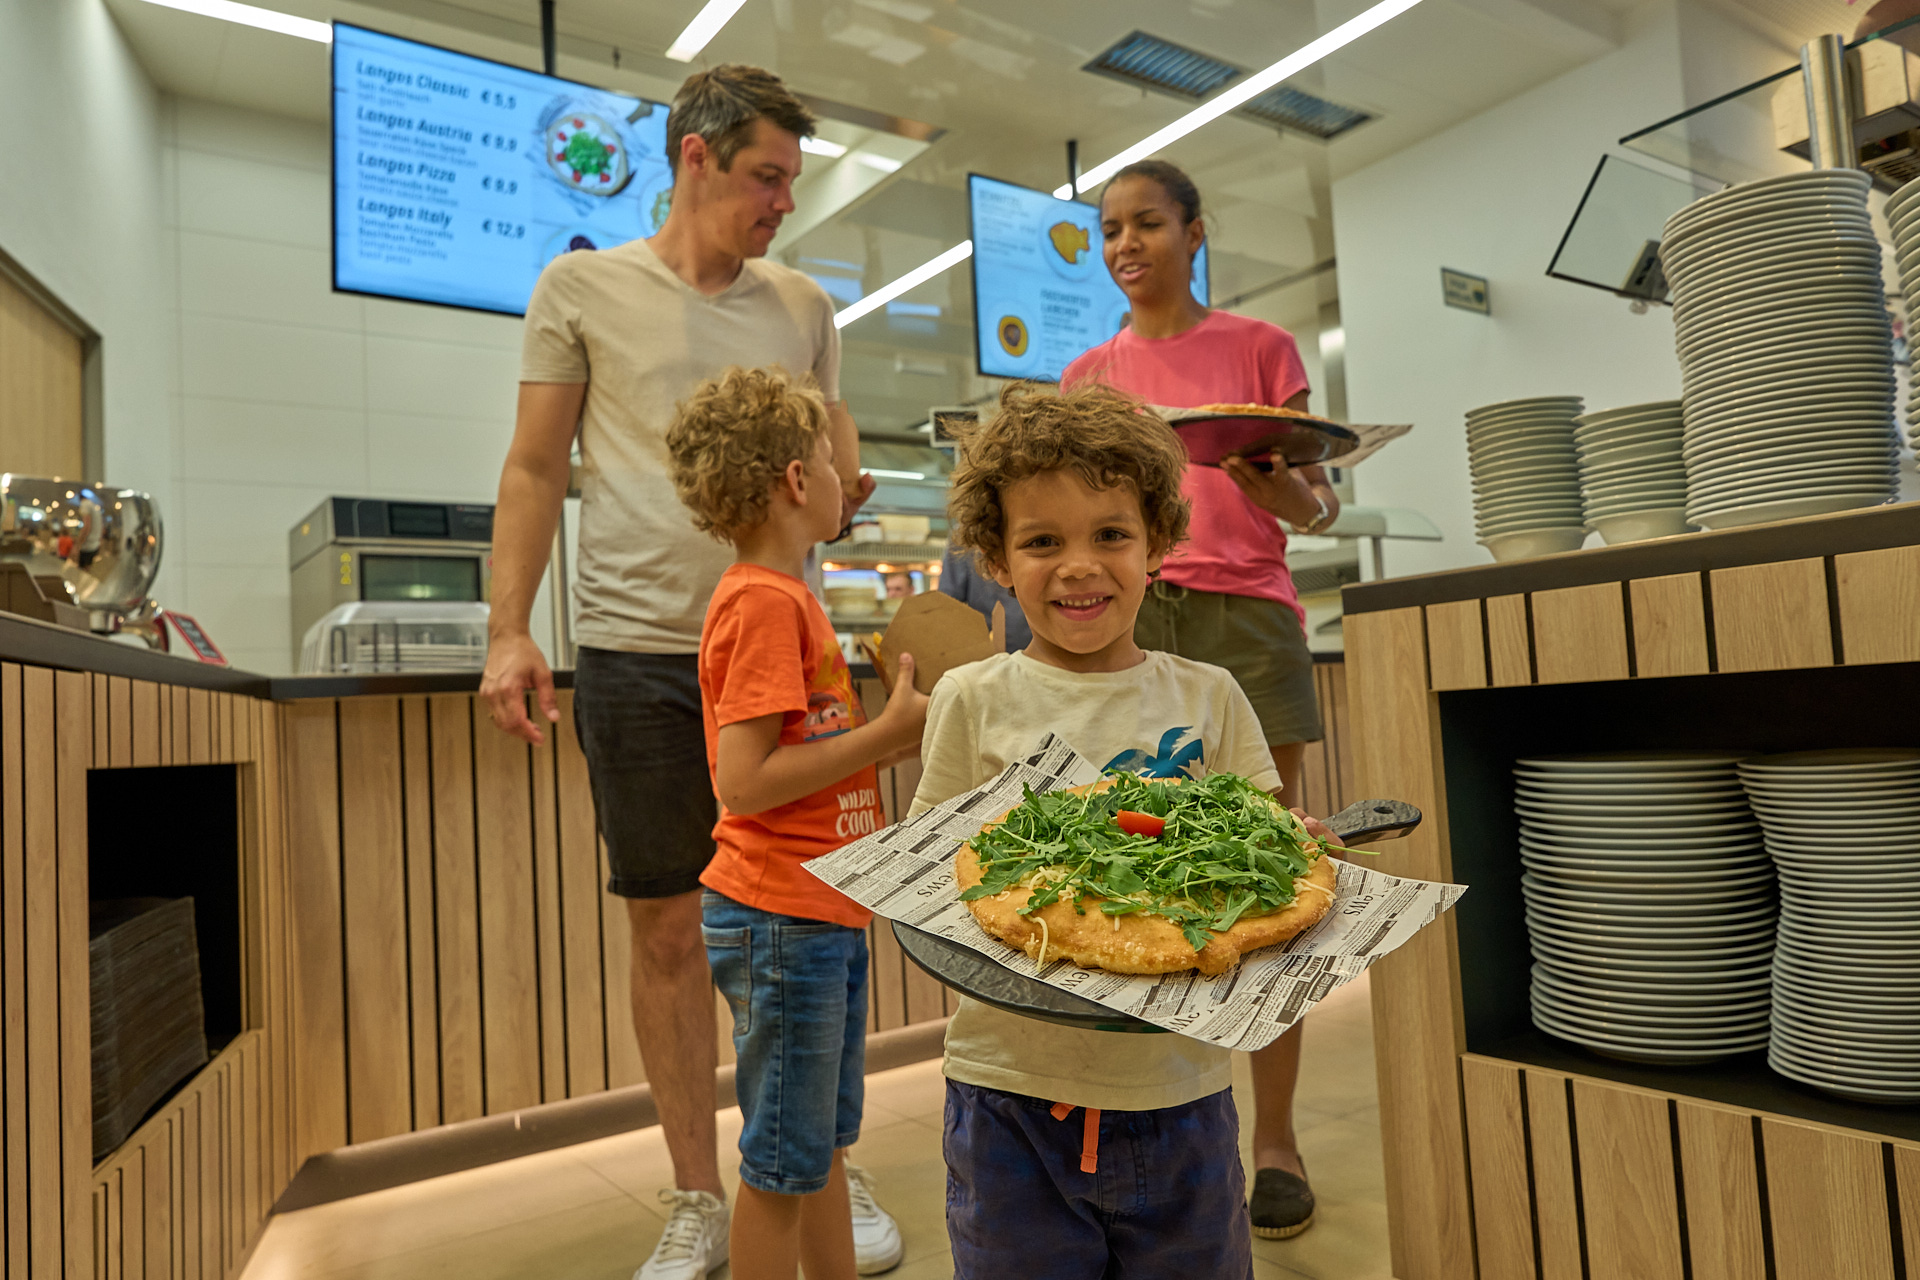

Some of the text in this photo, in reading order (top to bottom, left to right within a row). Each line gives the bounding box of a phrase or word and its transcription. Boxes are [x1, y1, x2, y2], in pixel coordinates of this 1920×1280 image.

[417, 73, 470, 99] Classic
[417, 119, 473, 143] Austria
[417, 162, 456, 182] Pizza
[417, 207, 452, 229] Italy
[917, 871, 954, 898] ews
